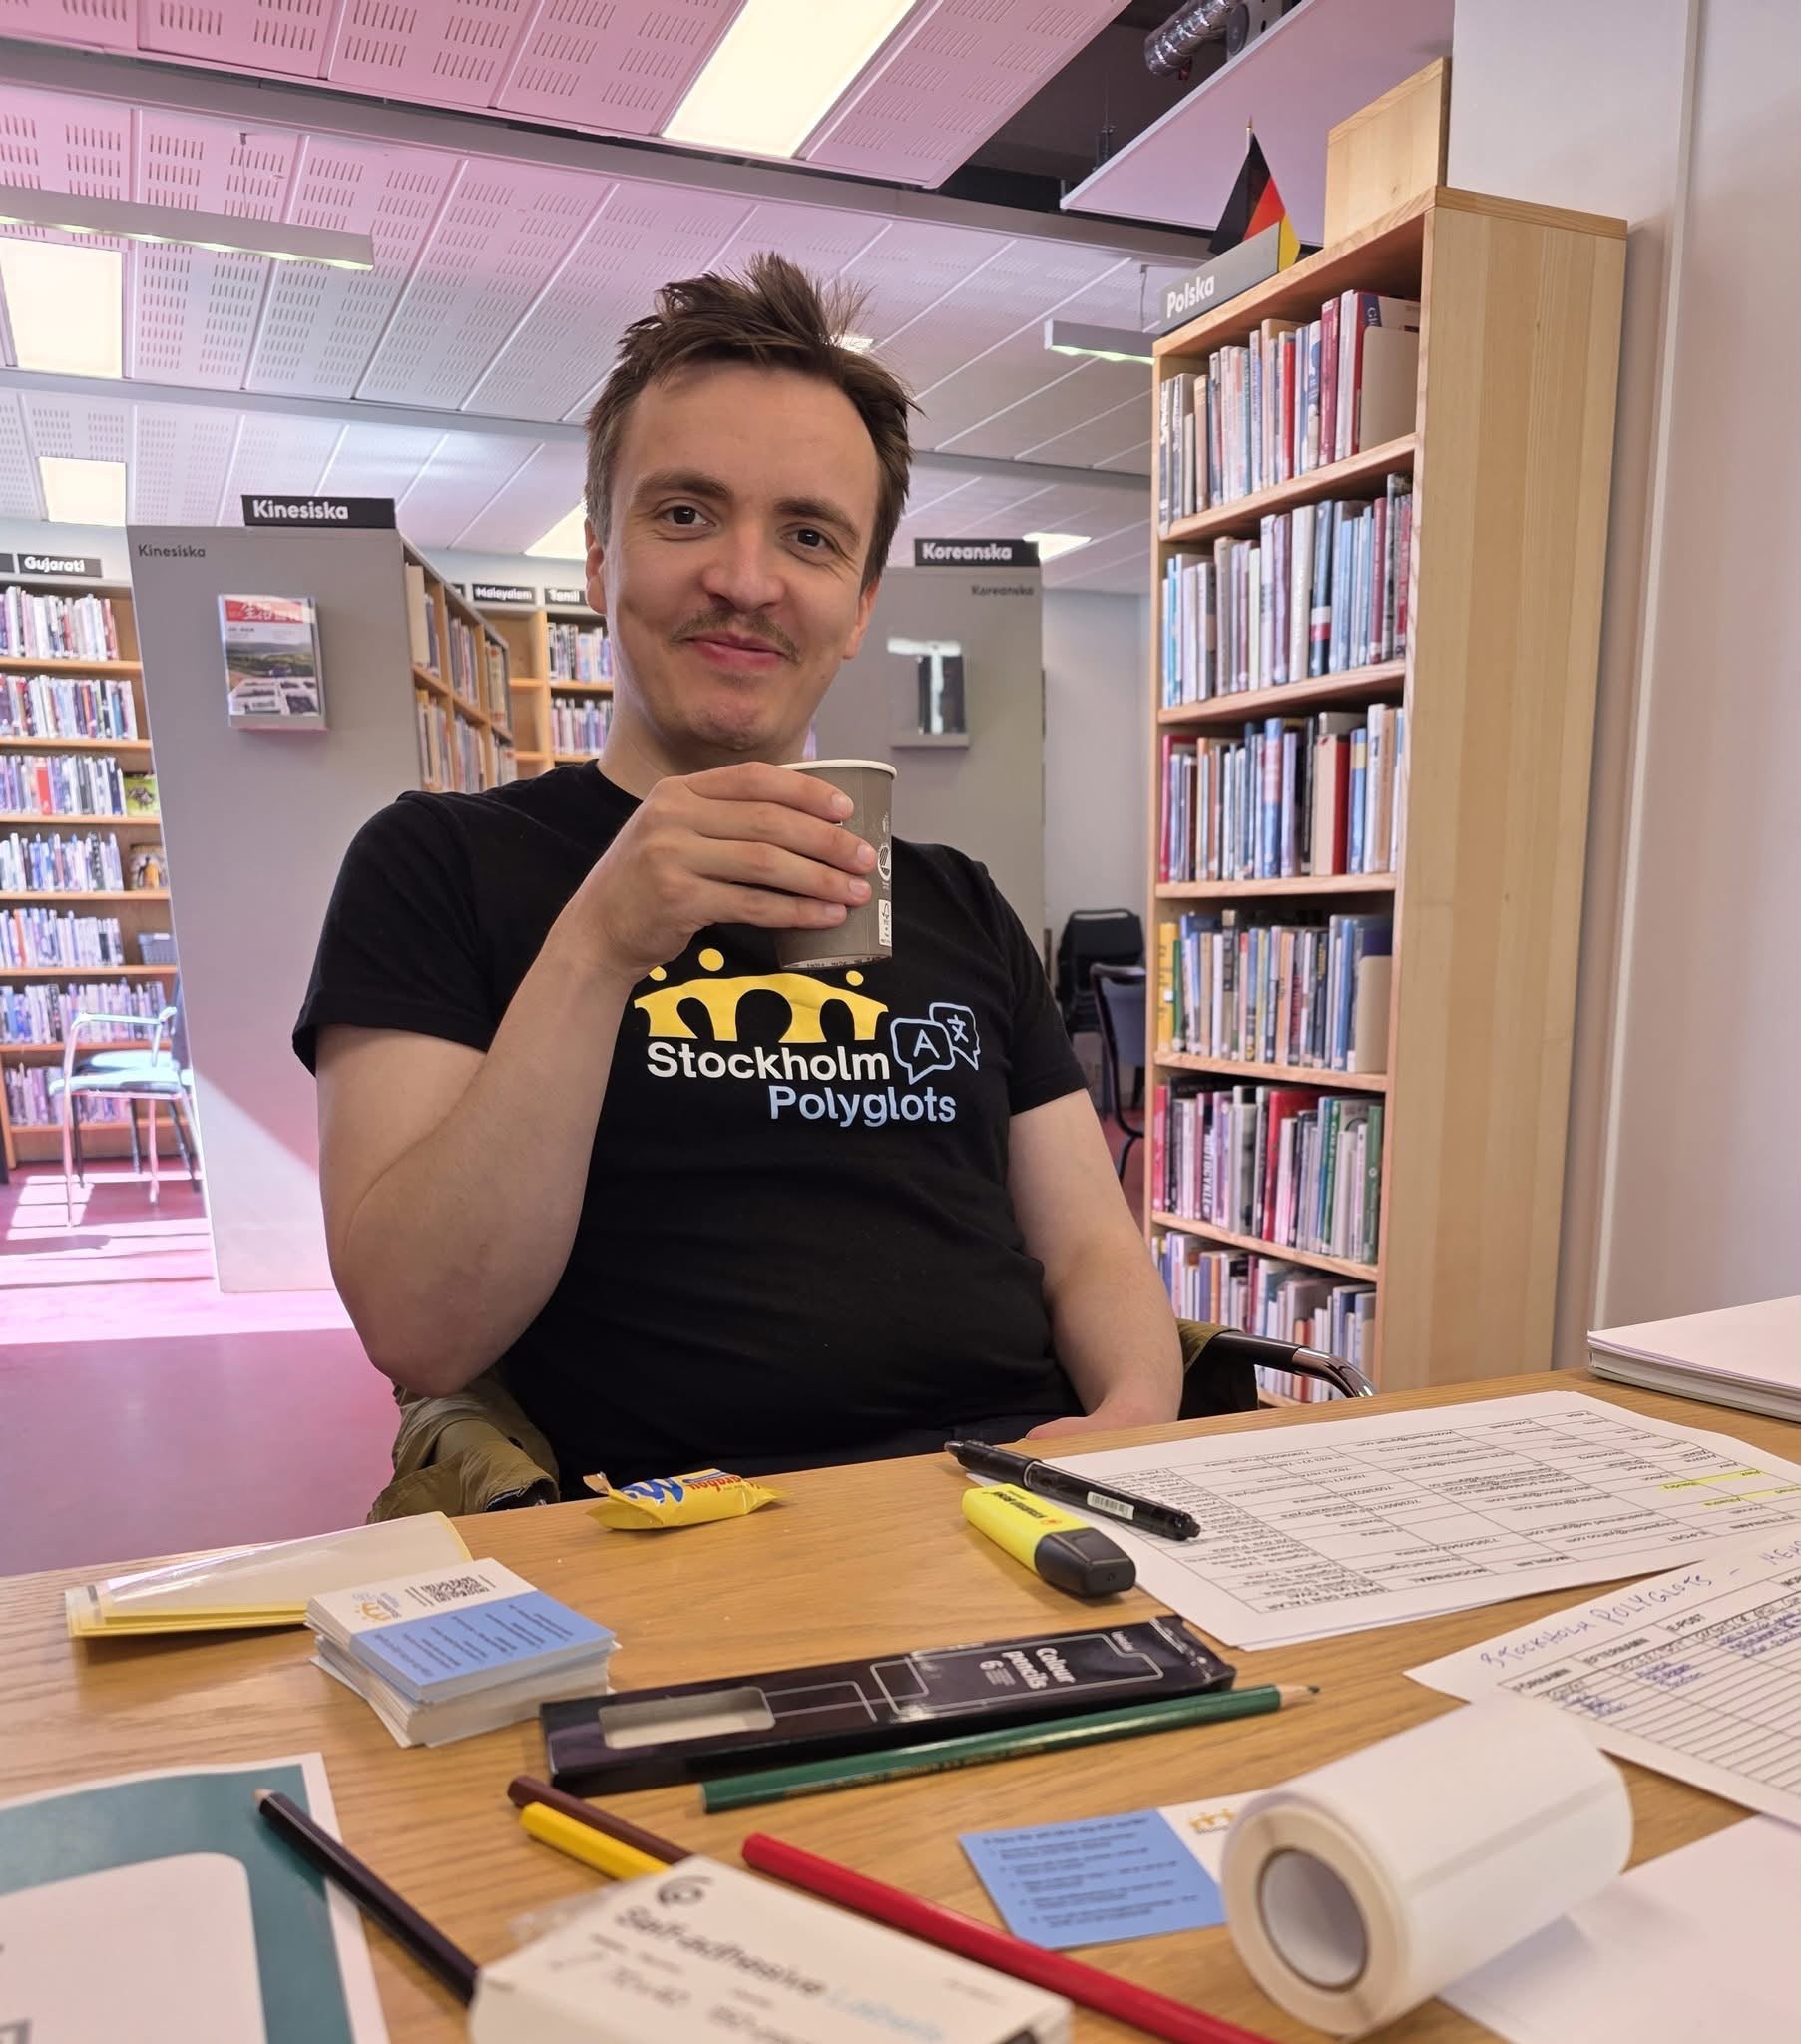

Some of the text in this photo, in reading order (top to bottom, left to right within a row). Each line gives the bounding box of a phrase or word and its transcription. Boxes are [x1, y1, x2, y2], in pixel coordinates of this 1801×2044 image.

[1166, 274, 1214, 319] Polska
[252, 500, 349, 520] Kinesiska
[24, 556, 85, 573] Gujarati
[138, 543, 207, 559] Kinesiska
[922, 542, 1013, 561] Koreanska
[971, 585, 1034, 597] Koreanska
[647, 1040, 890, 1081] Stockholm
[768, 1085, 957, 1128] Polyglots
[1590, 1574, 1713, 1626] POLYGLOTS
[980, 1660, 1004, 1670] 6
[1001, 1650, 1049, 1689] pencils
[1036, 1647, 1076, 1683] Colour
